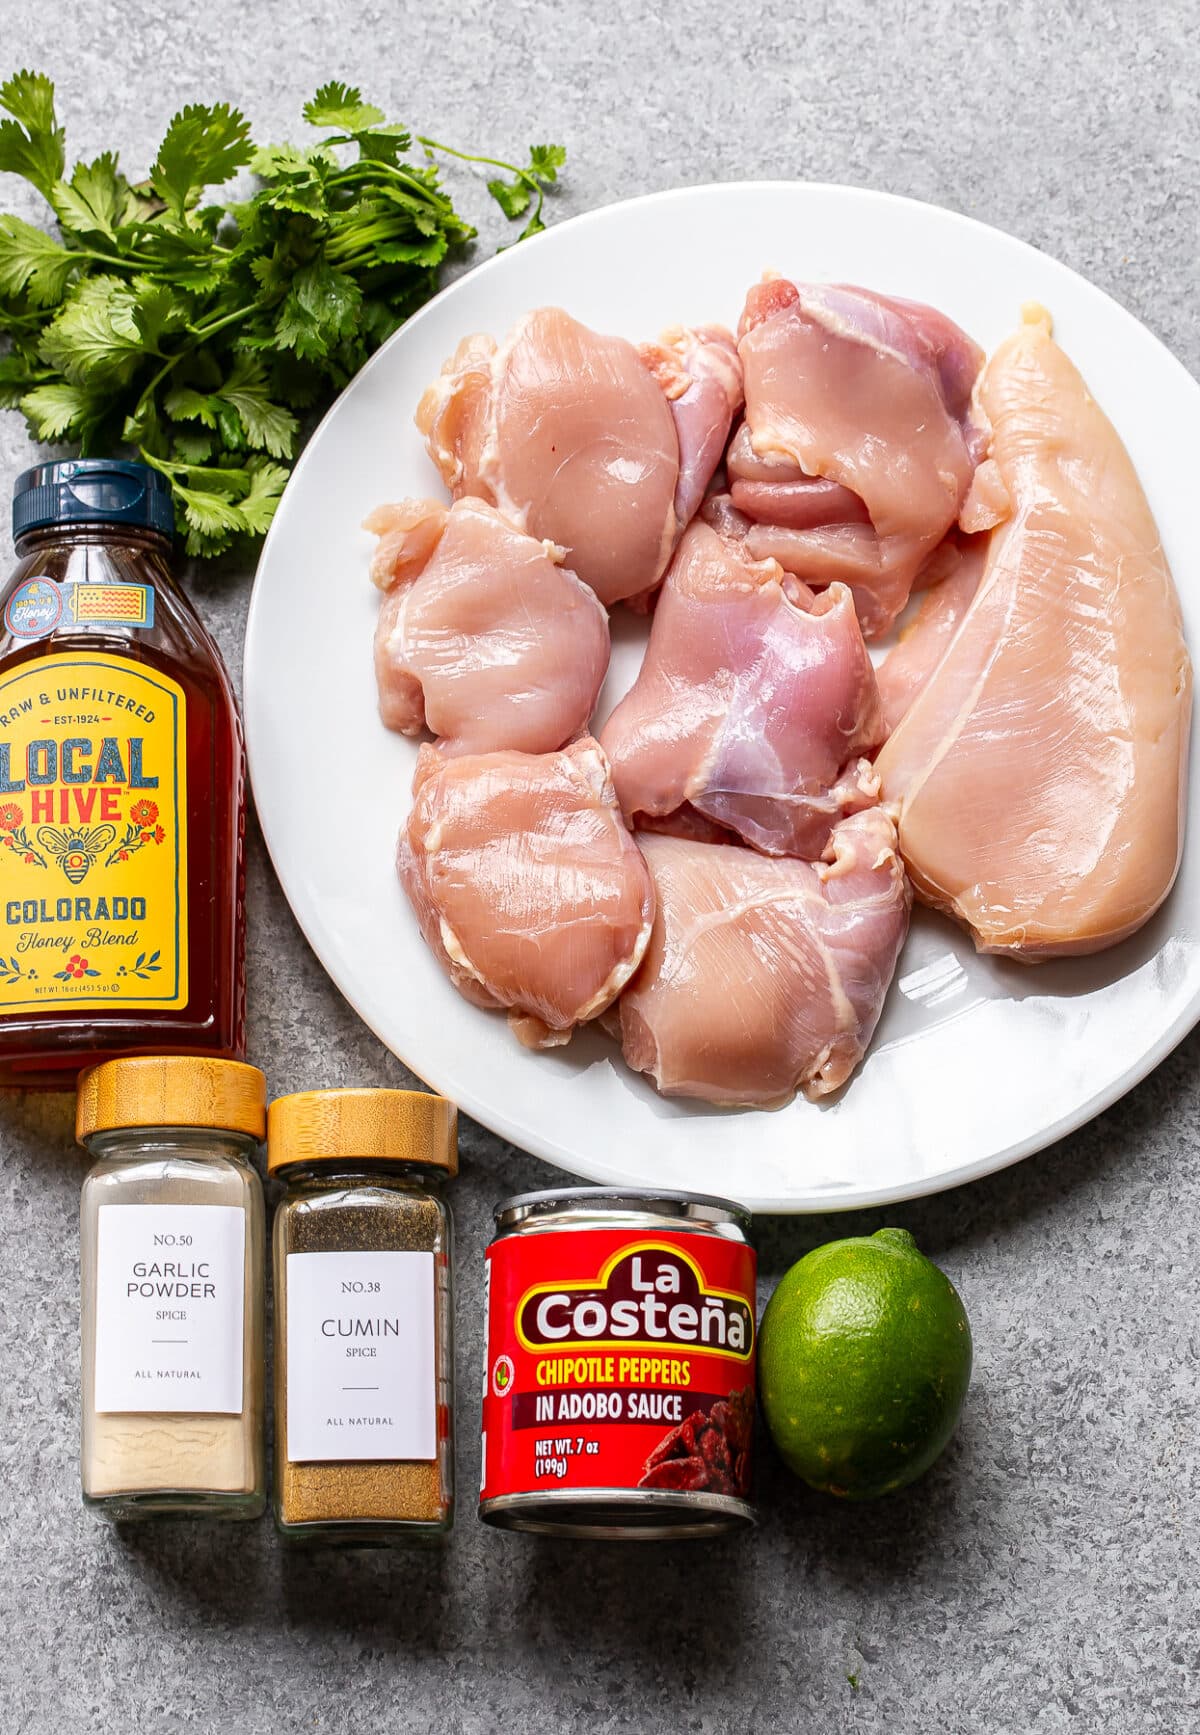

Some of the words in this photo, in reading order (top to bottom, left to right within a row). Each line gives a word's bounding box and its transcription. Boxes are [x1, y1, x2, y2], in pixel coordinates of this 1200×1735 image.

[13, 606, 56, 622] Honey
[0, 698, 33, 727] RAW
[39, 693, 51, 705] &
[57, 687, 156, 724] UNFILTERED
[0, 737, 159, 794] LOCAL
[31, 787, 122, 824] HIVE
[6, 896, 147, 925] COLORADO
[16, 932, 76, 953] Honey
[80, 927, 139, 948] Blend
[153, 1234, 193, 1246] NO.50
[133, 1262, 210, 1278] GARLIC
[631, 1256, 680, 1293] La
[127, 1282, 216, 1298] POWDER
[341, 1281, 381, 1293] NO.38
[155, 1310, 187, 1320] SPICE
[536, 1294, 745, 1349] Costeña
[321, 1318, 400, 1337] CUMIN
[345, 1347, 377, 1357] SPICE
[134, 1370, 152, 1379] ALL
[157, 1370, 202, 1379] NATURAL
[536, 1357, 614, 1386] CHIPOTLE
[619, 1358, 691, 1386] PEPPERS
[536, 1395, 554, 1421] IN
[558, 1393, 623, 1420] ADOBO
[628, 1393, 682, 1420] SAUCE
[326, 1418, 344, 1426] ALL
[348, 1417, 393, 1426] NATURAL
[535, 1440, 552, 1456] NET
[554, 1439, 574, 1454] WT.
[576, 1438, 583, 1453] 7
[586, 1441, 599, 1454] oz
[535, 1458, 567, 1478] (199g)
